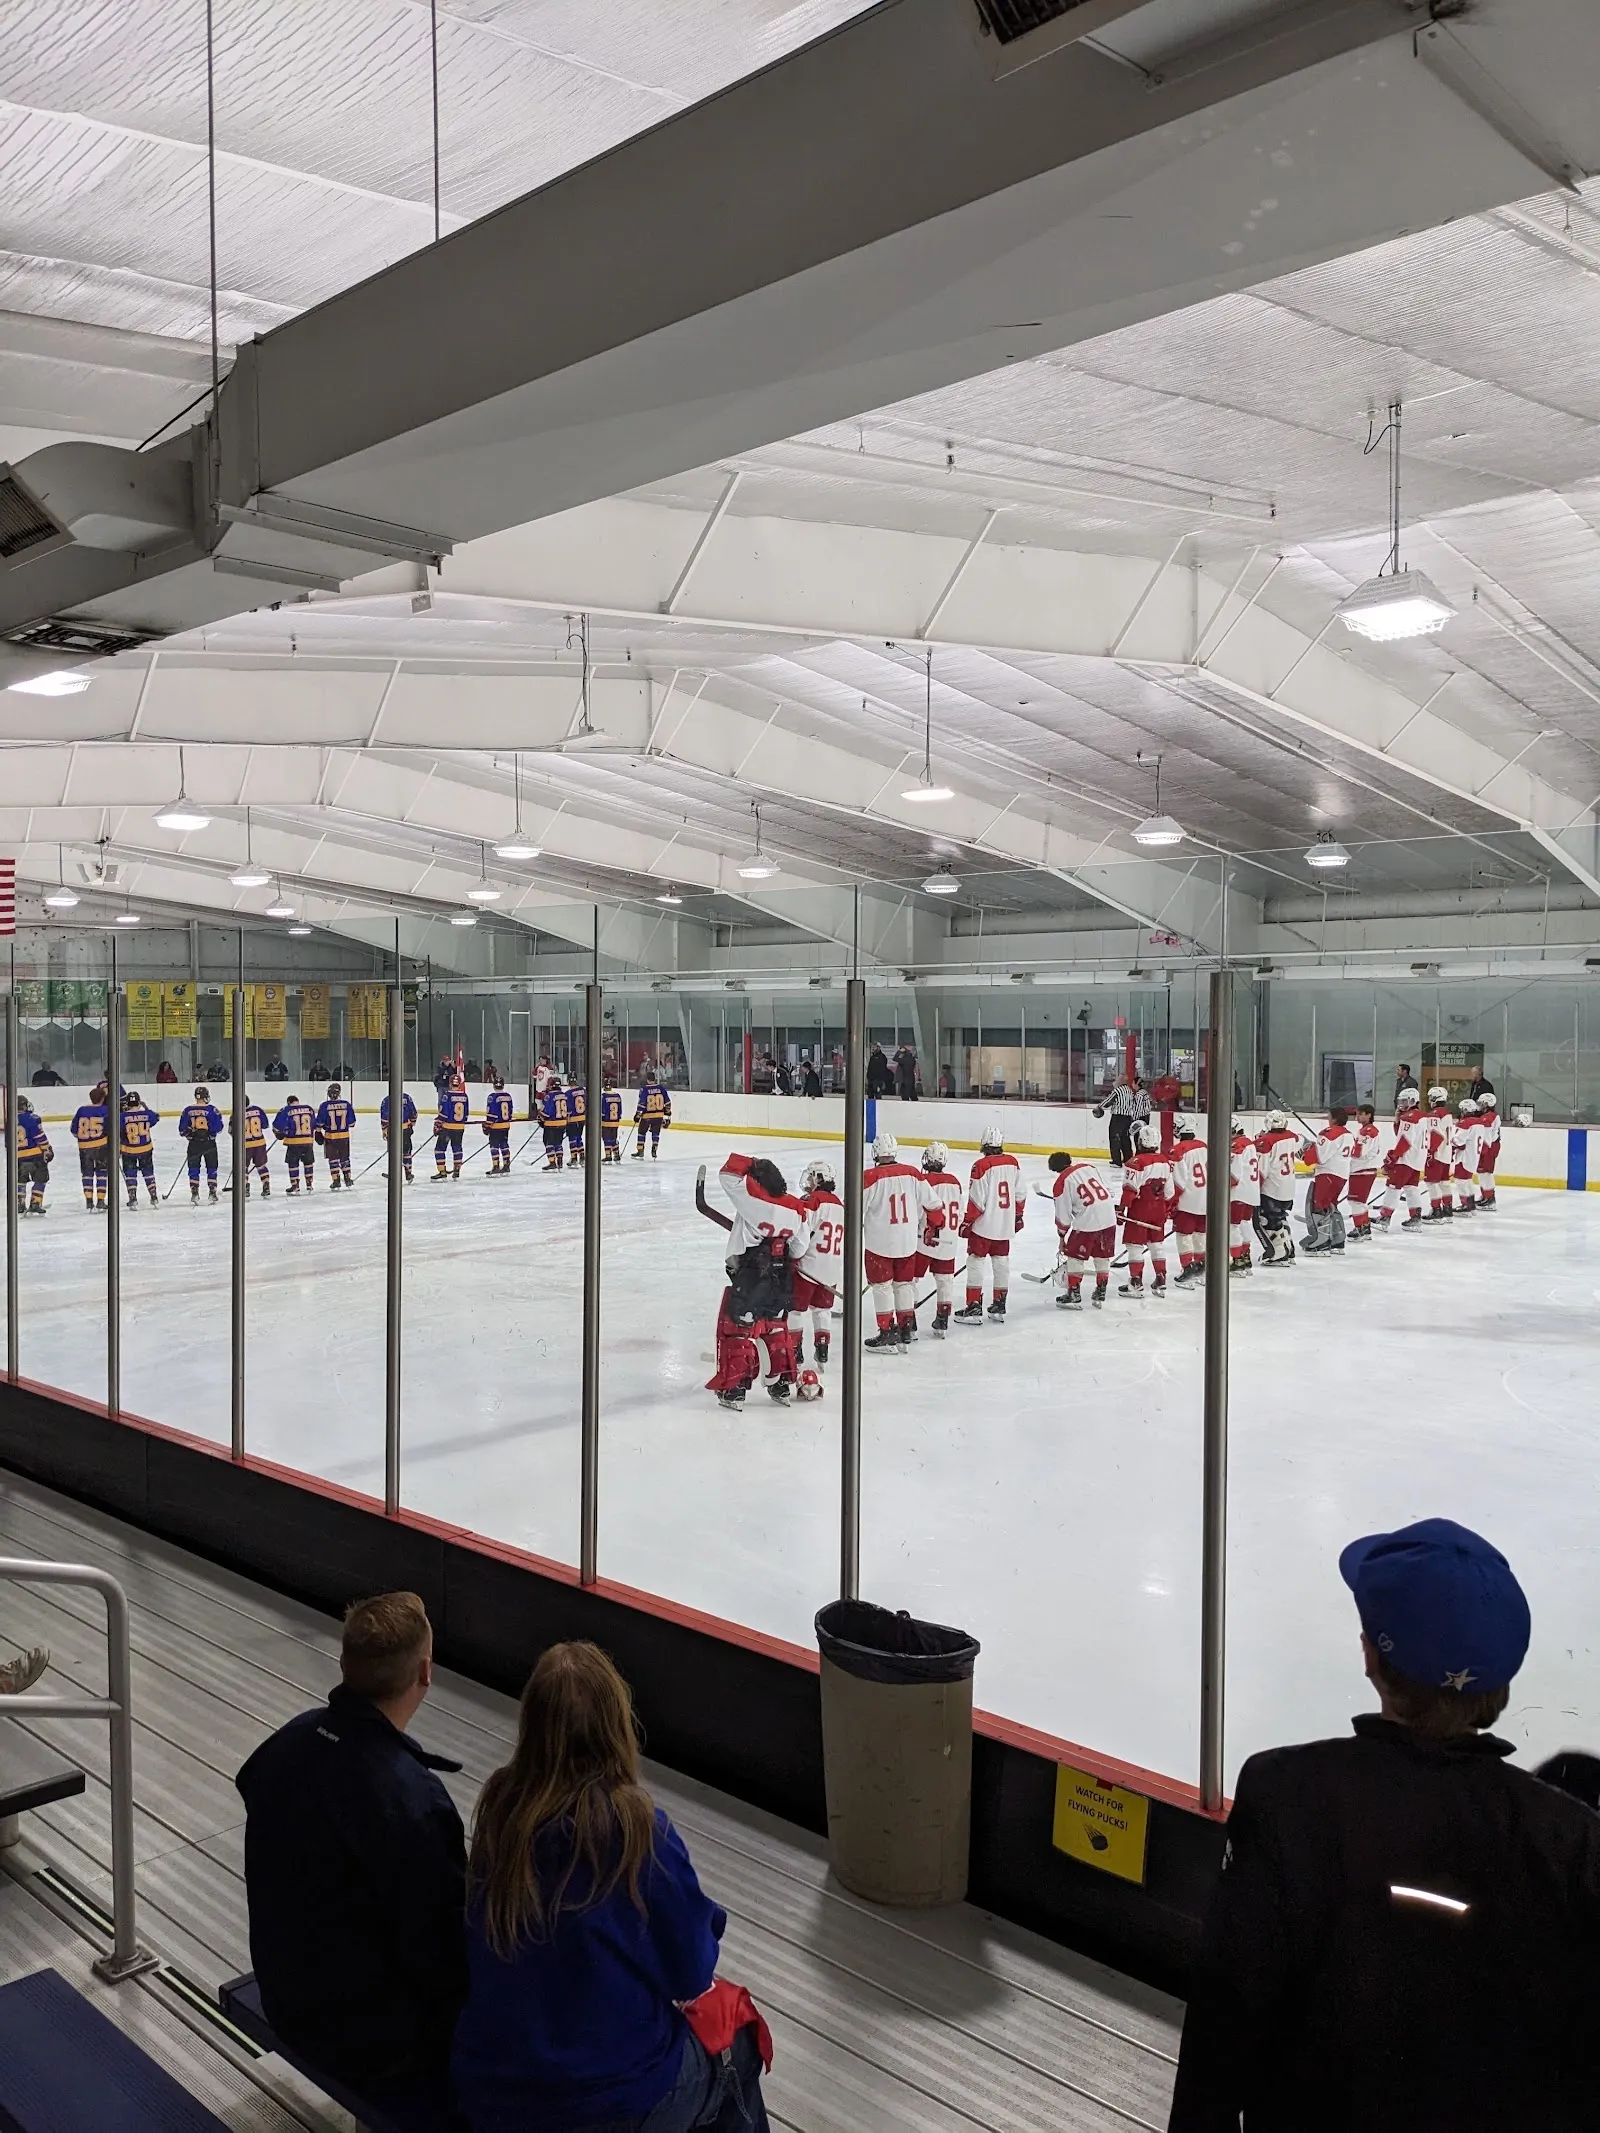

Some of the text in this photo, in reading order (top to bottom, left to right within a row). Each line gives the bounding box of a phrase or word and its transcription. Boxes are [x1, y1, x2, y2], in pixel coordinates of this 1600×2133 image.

[329, 1110, 347, 1130] 17
[998, 1181, 1010, 1208] 9
[1077, 1177, 1109, 1207] 98
[889, 1193, 909, 1224] 11
[816, 1222, 843, 1255] 32
[1075, 1785, 1124, 1812] WATCH FOR
[1068, 1799, 1128, 1831] FLYING PUCKS!
